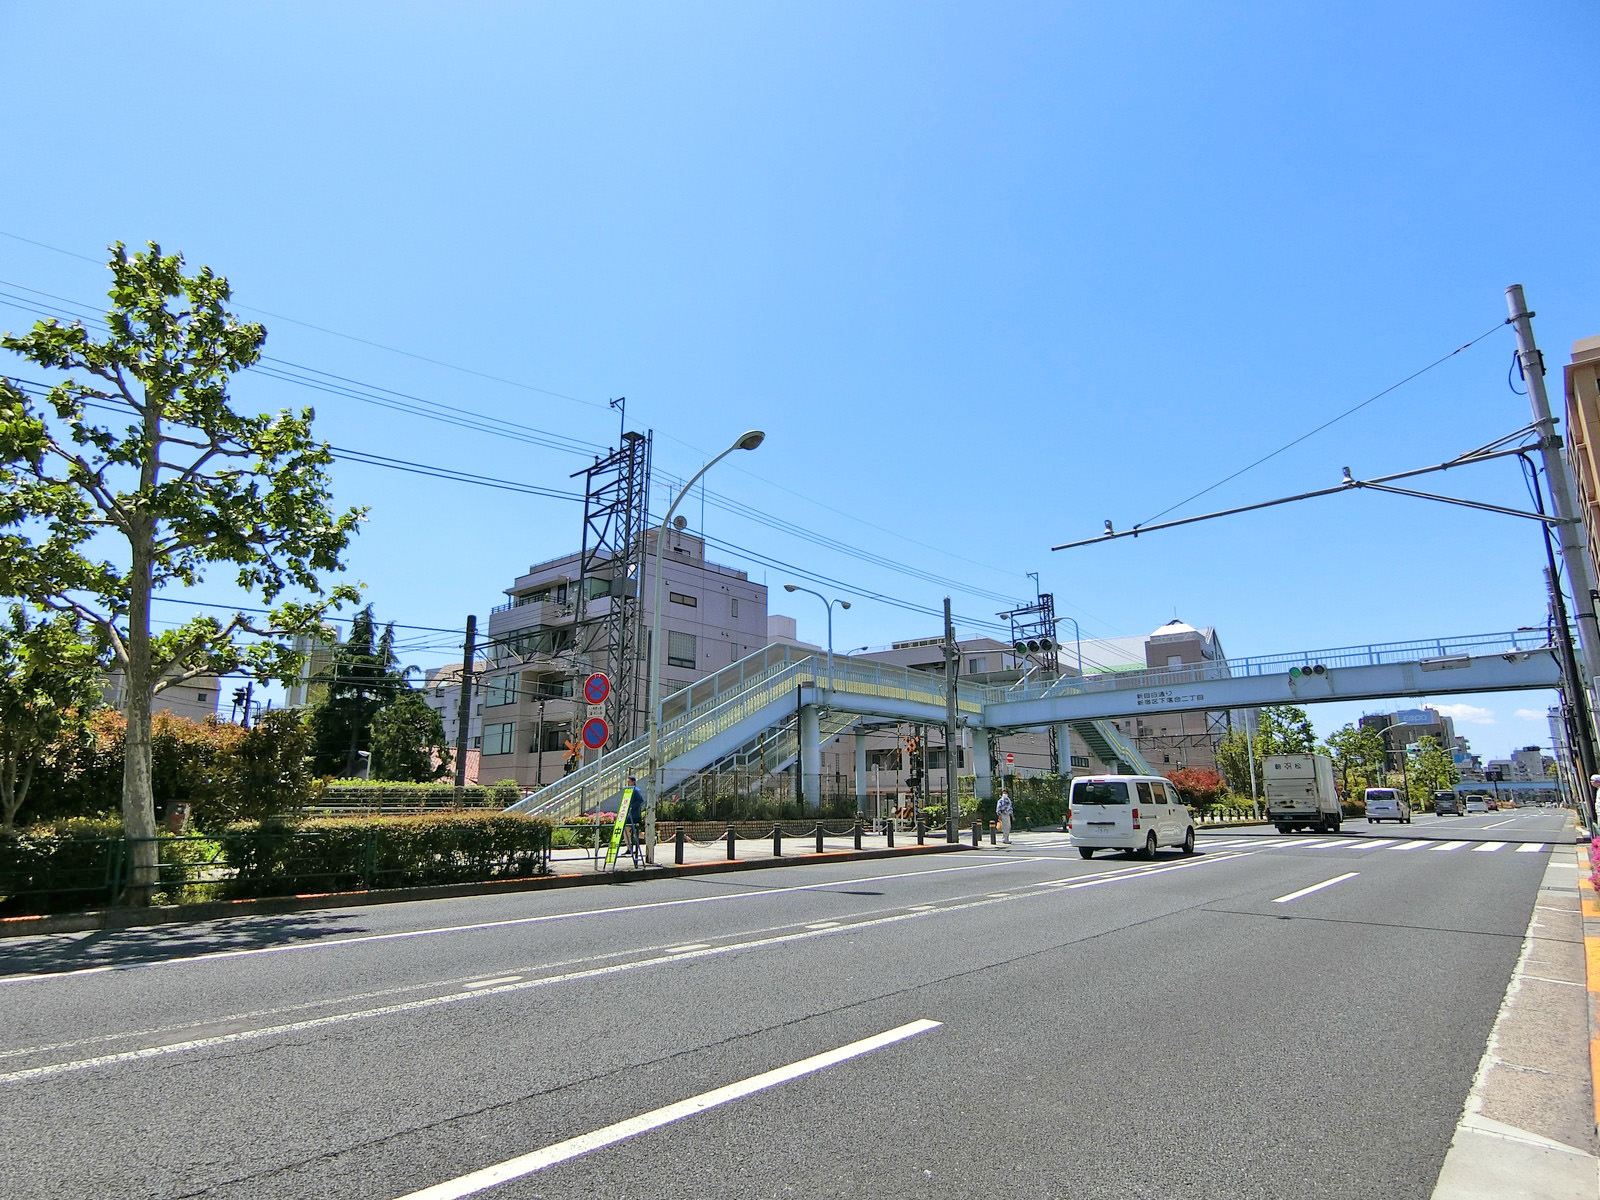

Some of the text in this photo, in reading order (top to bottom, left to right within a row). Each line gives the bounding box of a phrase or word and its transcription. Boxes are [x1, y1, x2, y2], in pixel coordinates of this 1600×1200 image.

[1137, 690, 1173, 699] 新目白通り
[1137, 694, 1204, 705] 新宿区下落合二丁目
